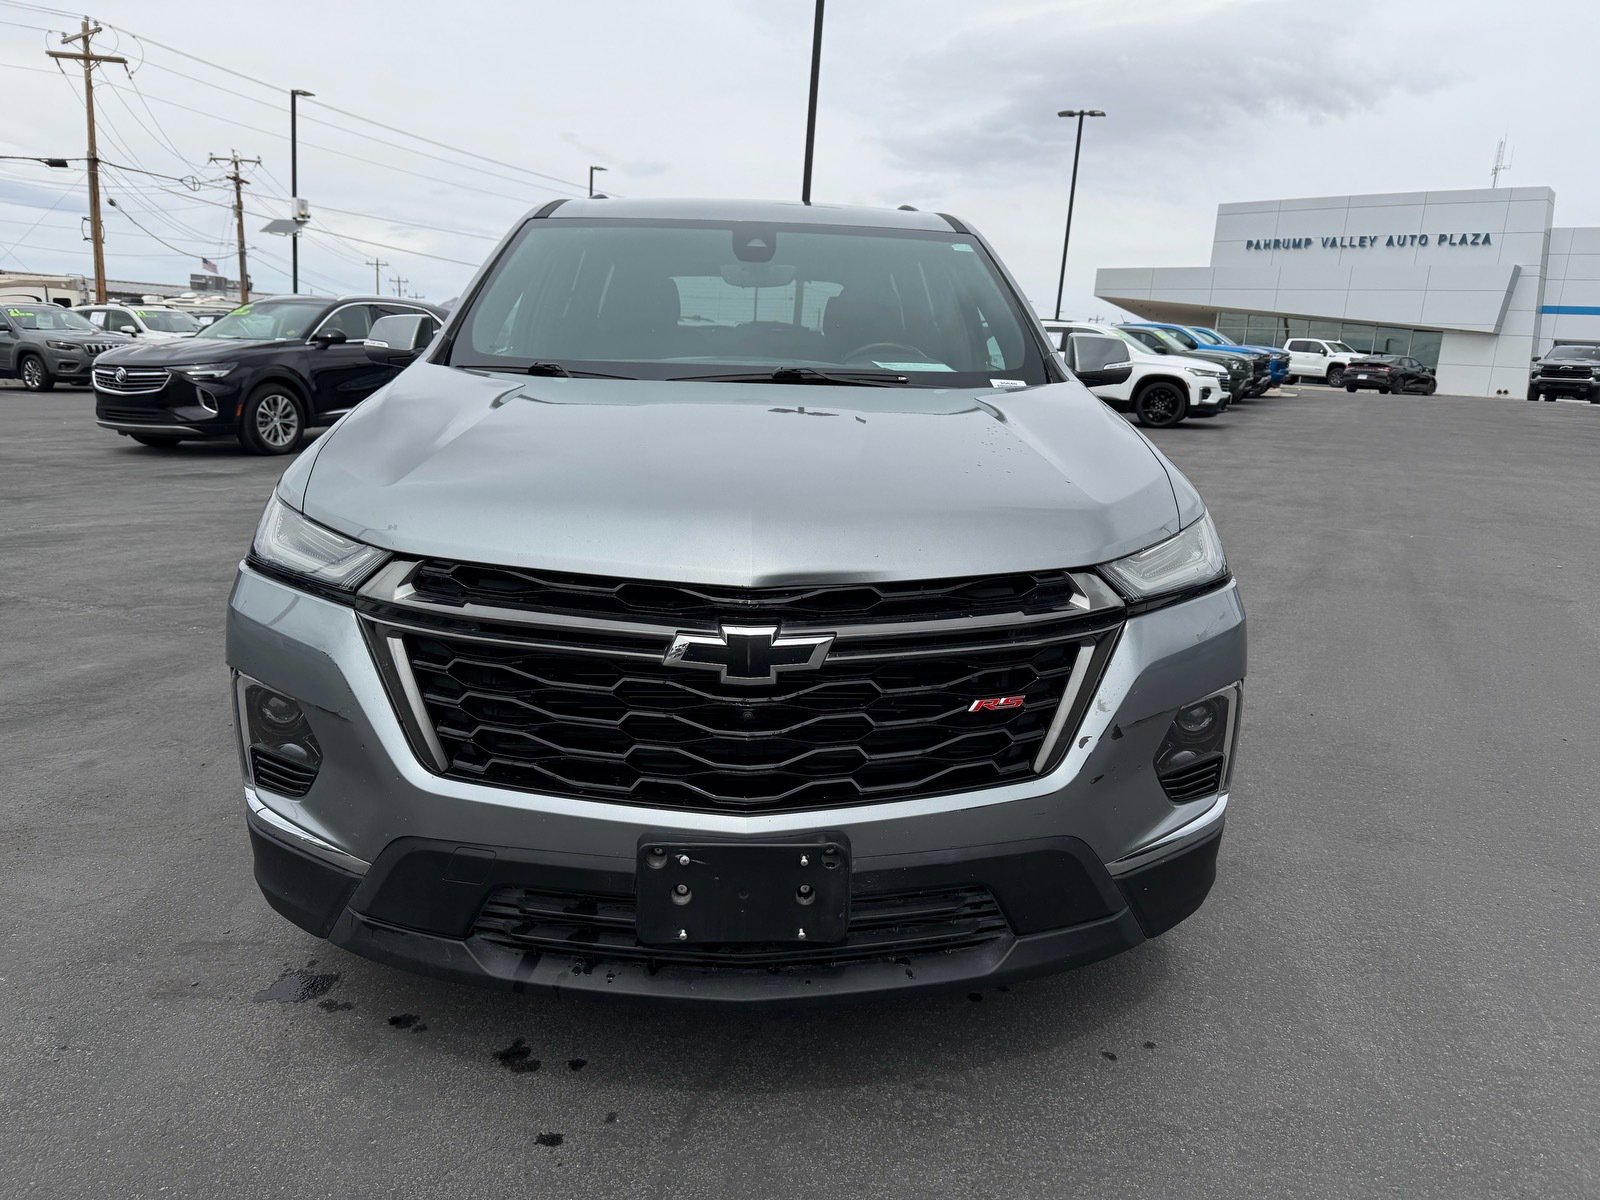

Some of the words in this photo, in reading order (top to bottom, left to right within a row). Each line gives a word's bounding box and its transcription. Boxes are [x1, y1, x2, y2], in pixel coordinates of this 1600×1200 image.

[1246, 237, 1313, 251] PAHRUMP
[1321, 235, 1377, 248] VALLEY
[1385, 234, 1428, 247] AUTO
[1437, 233, 1492, 246] PLAZA
[968, 695, 1026, 712] RS
